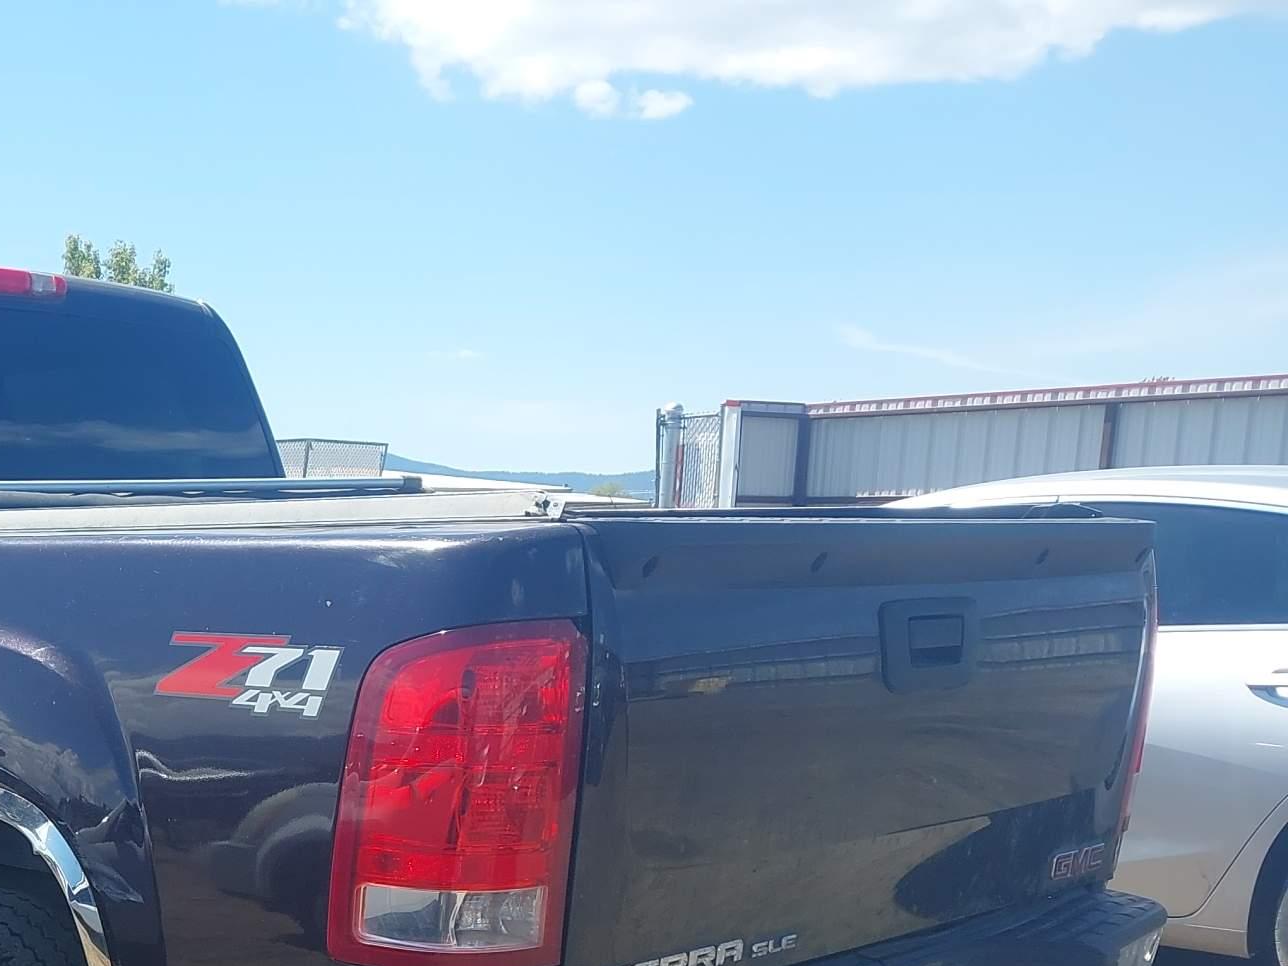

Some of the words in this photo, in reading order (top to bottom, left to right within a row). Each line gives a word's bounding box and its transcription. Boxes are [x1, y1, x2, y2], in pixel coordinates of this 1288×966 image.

[154, 631, 344, 698] Z71
[1051, 843, 1104, 881] GMC
[751, 934, 798, 959] SLE
